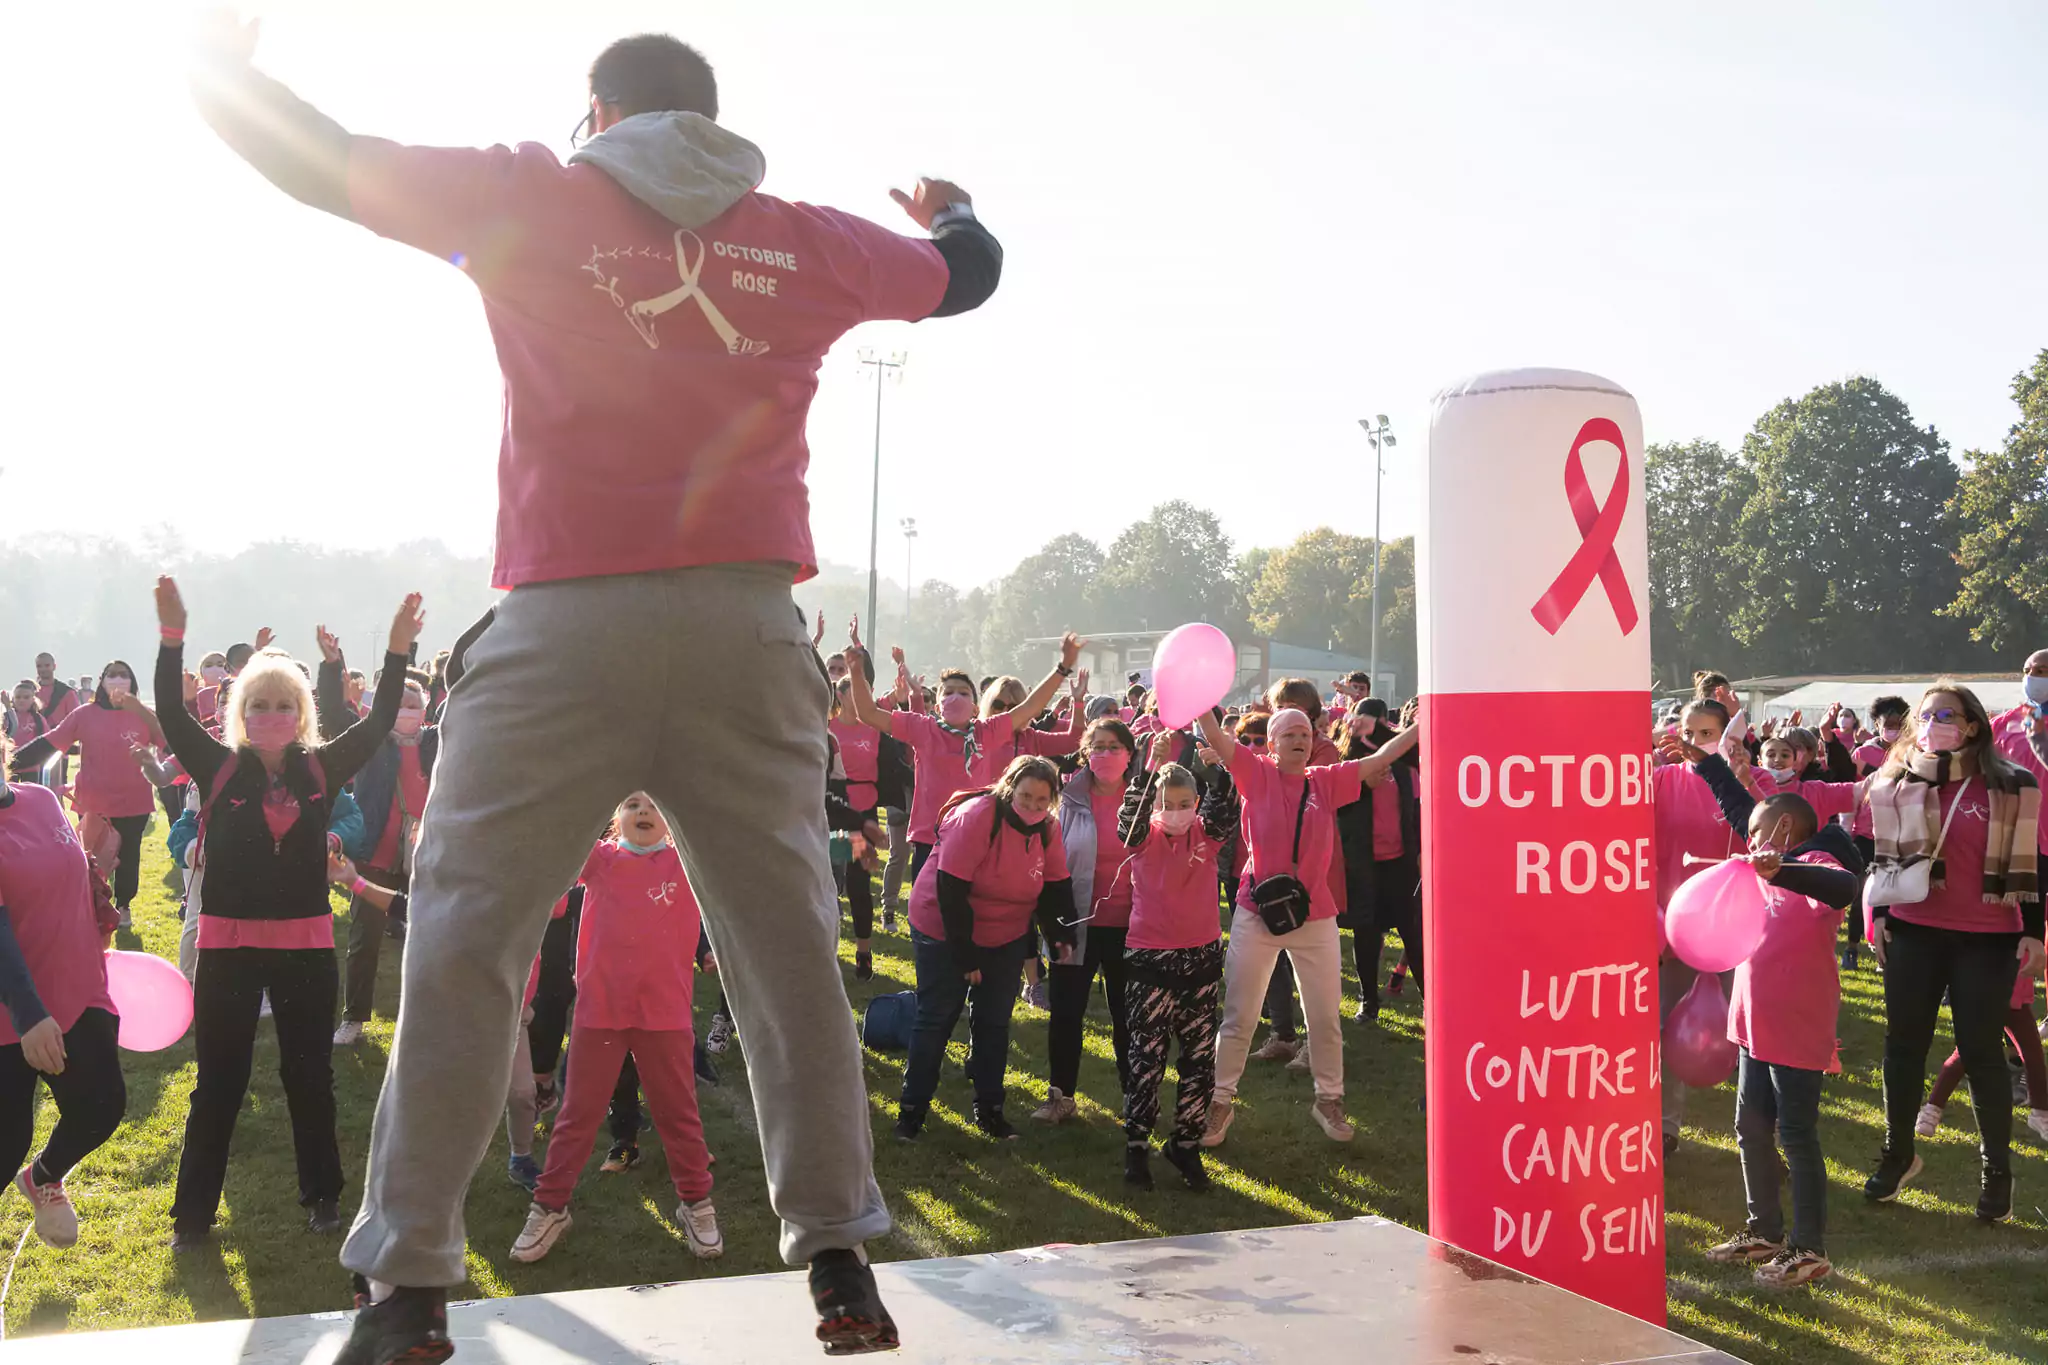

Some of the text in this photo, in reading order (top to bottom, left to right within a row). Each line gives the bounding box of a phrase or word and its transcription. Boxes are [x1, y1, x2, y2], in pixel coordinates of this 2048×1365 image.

[713, 240, 797, 272] OCTOBRE
[732, 270, 778, 297] ROSE
[1516, 837, 1650, 893] ROSE
[1519, 961, 1649, 1021] LUTTE
[1465, 1041, 1637, 1103] CONTRE
[1502, 1120, 1657, 1184] CANCER
[1493, 1194, 1657, 1262] DU SEIN
